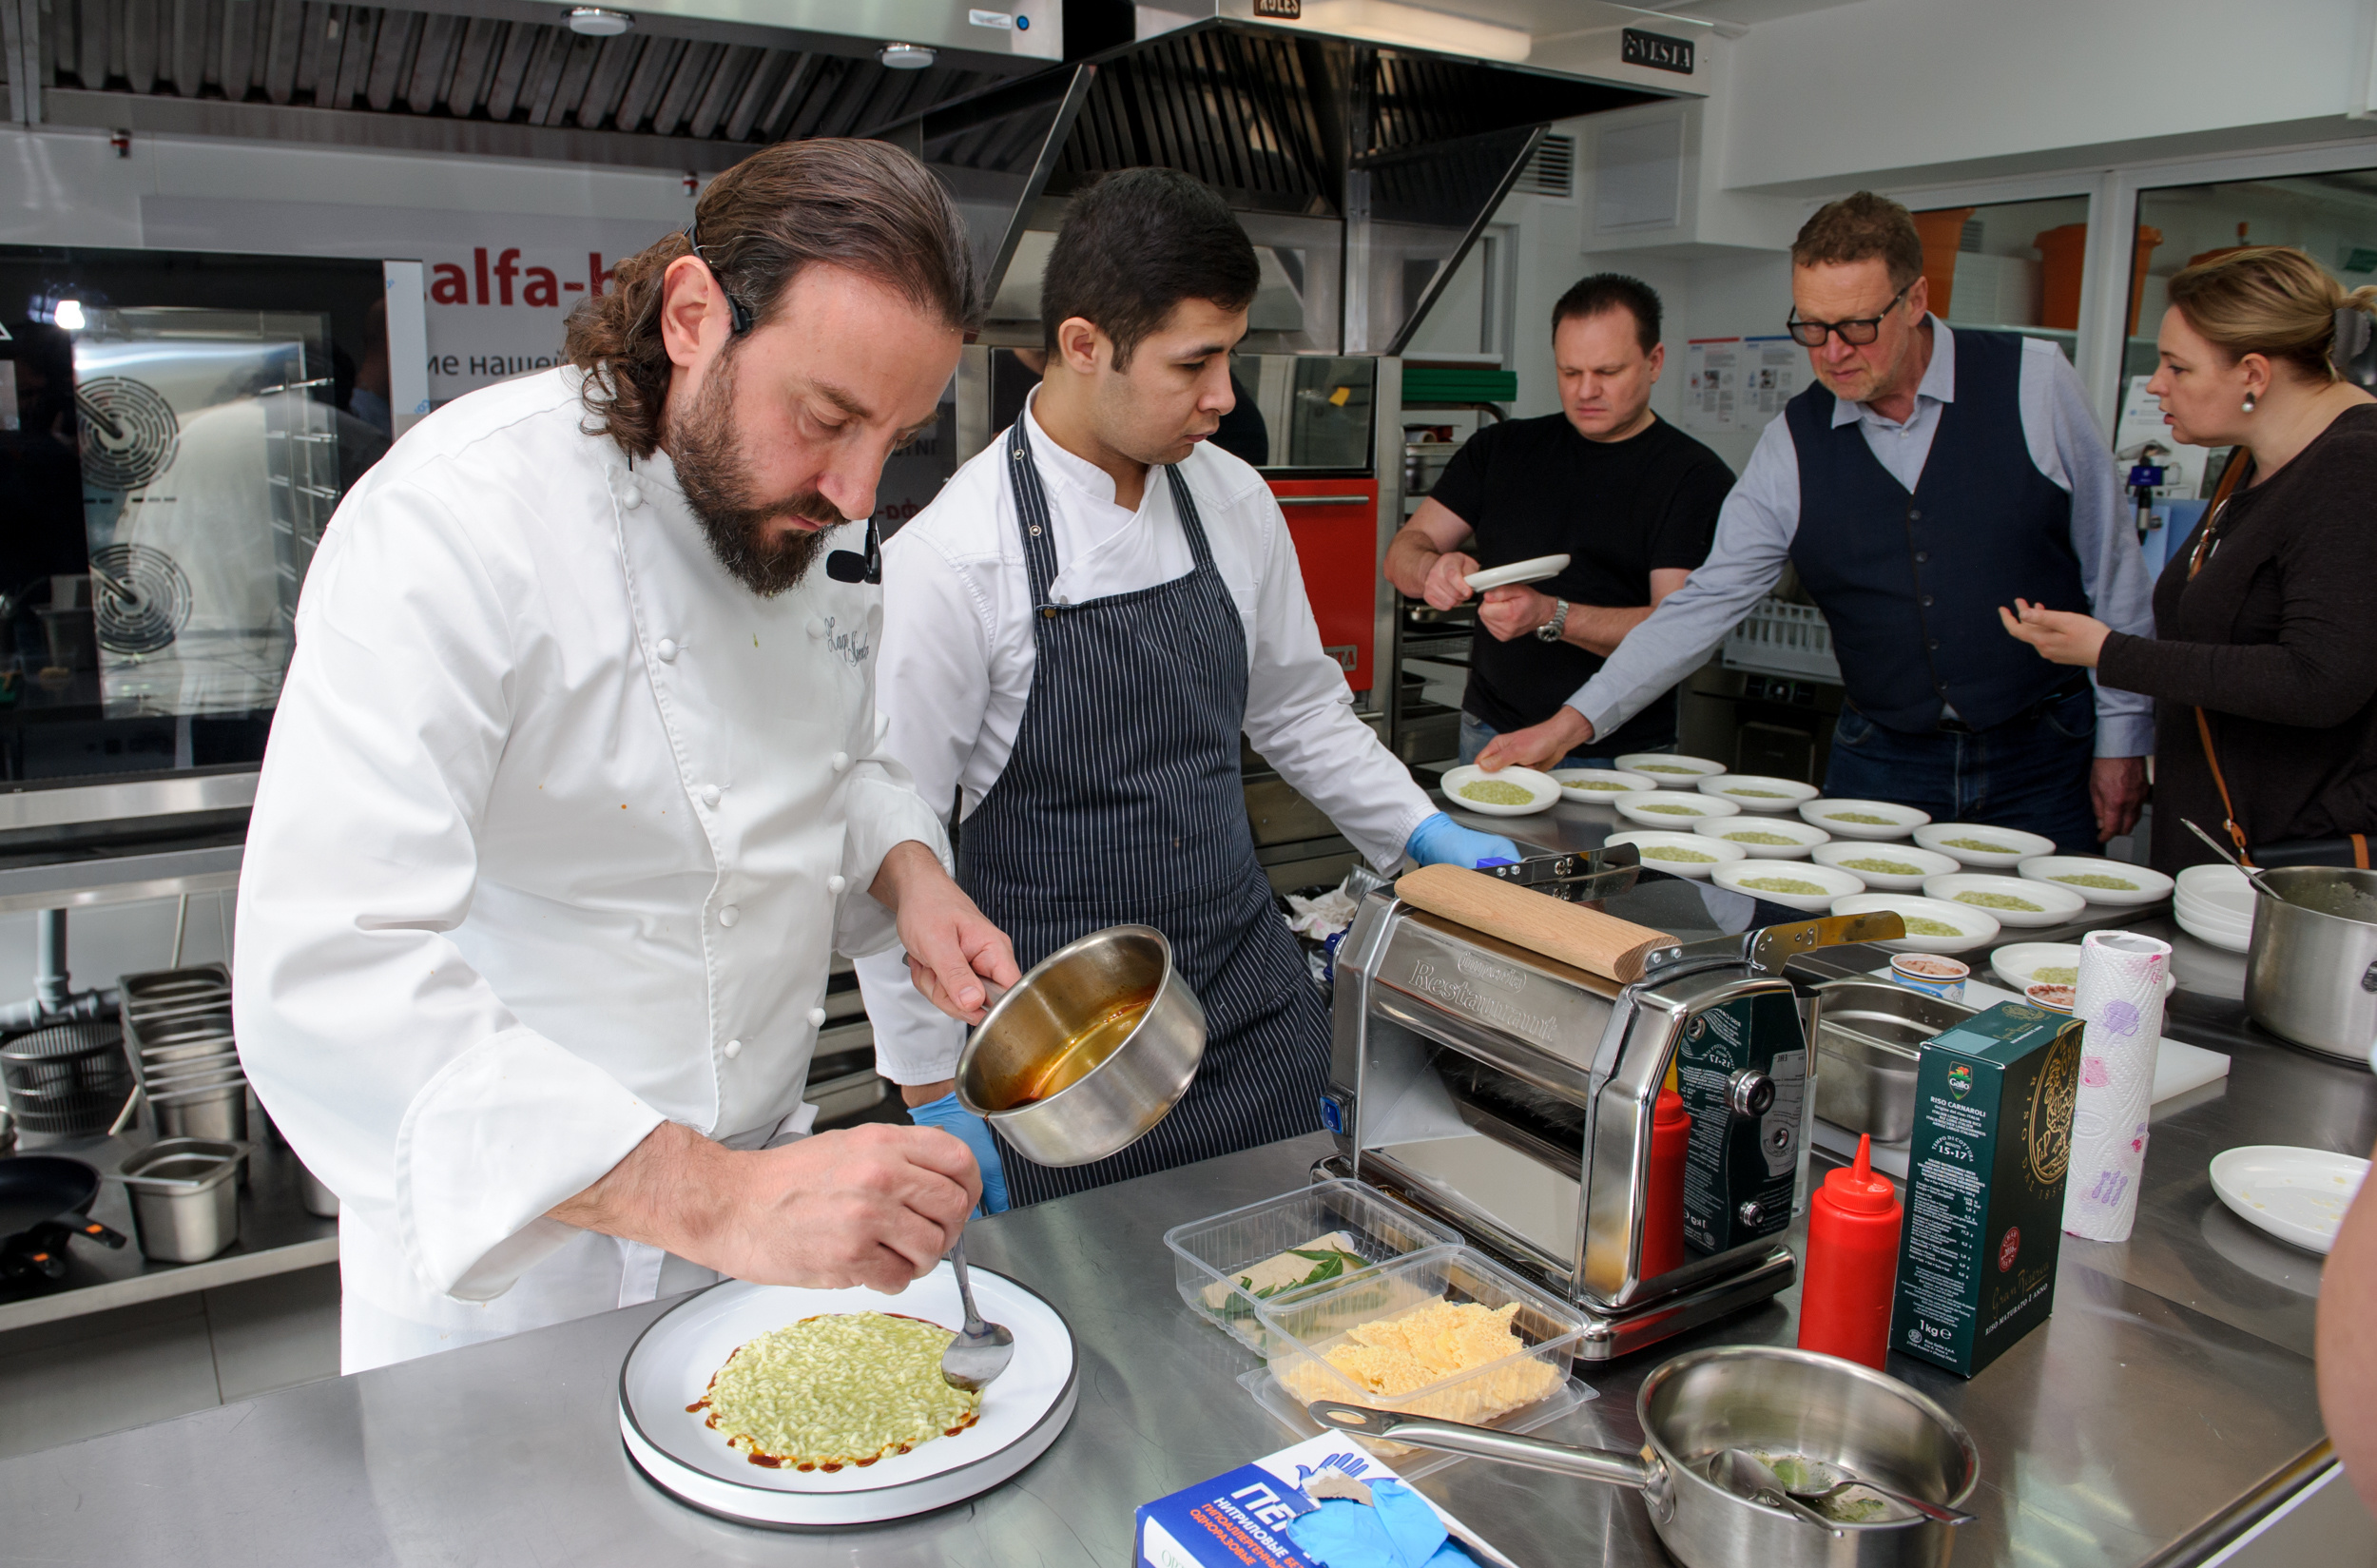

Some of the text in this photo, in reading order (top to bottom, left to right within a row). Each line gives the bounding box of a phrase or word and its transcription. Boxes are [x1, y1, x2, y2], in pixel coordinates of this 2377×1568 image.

[1408, 959, 1557, 1042] Restaurant
[1930, 1095, 1985, 1117] RISO CARNAROLI
[1949, 1077, 1970, 1090] Gallo
[1985, 1321, 1999, 1336] RISO
[1999, 1298, 2027, 1326] MATURATO
[2033, 1283, 2048, 1299] ANNO
[1189, 1509, 1257, 1566] ОДНОРАЗОВЫЕ
[1213, 1497, 1289, 1558] НИТРИЛОВЫЕ
